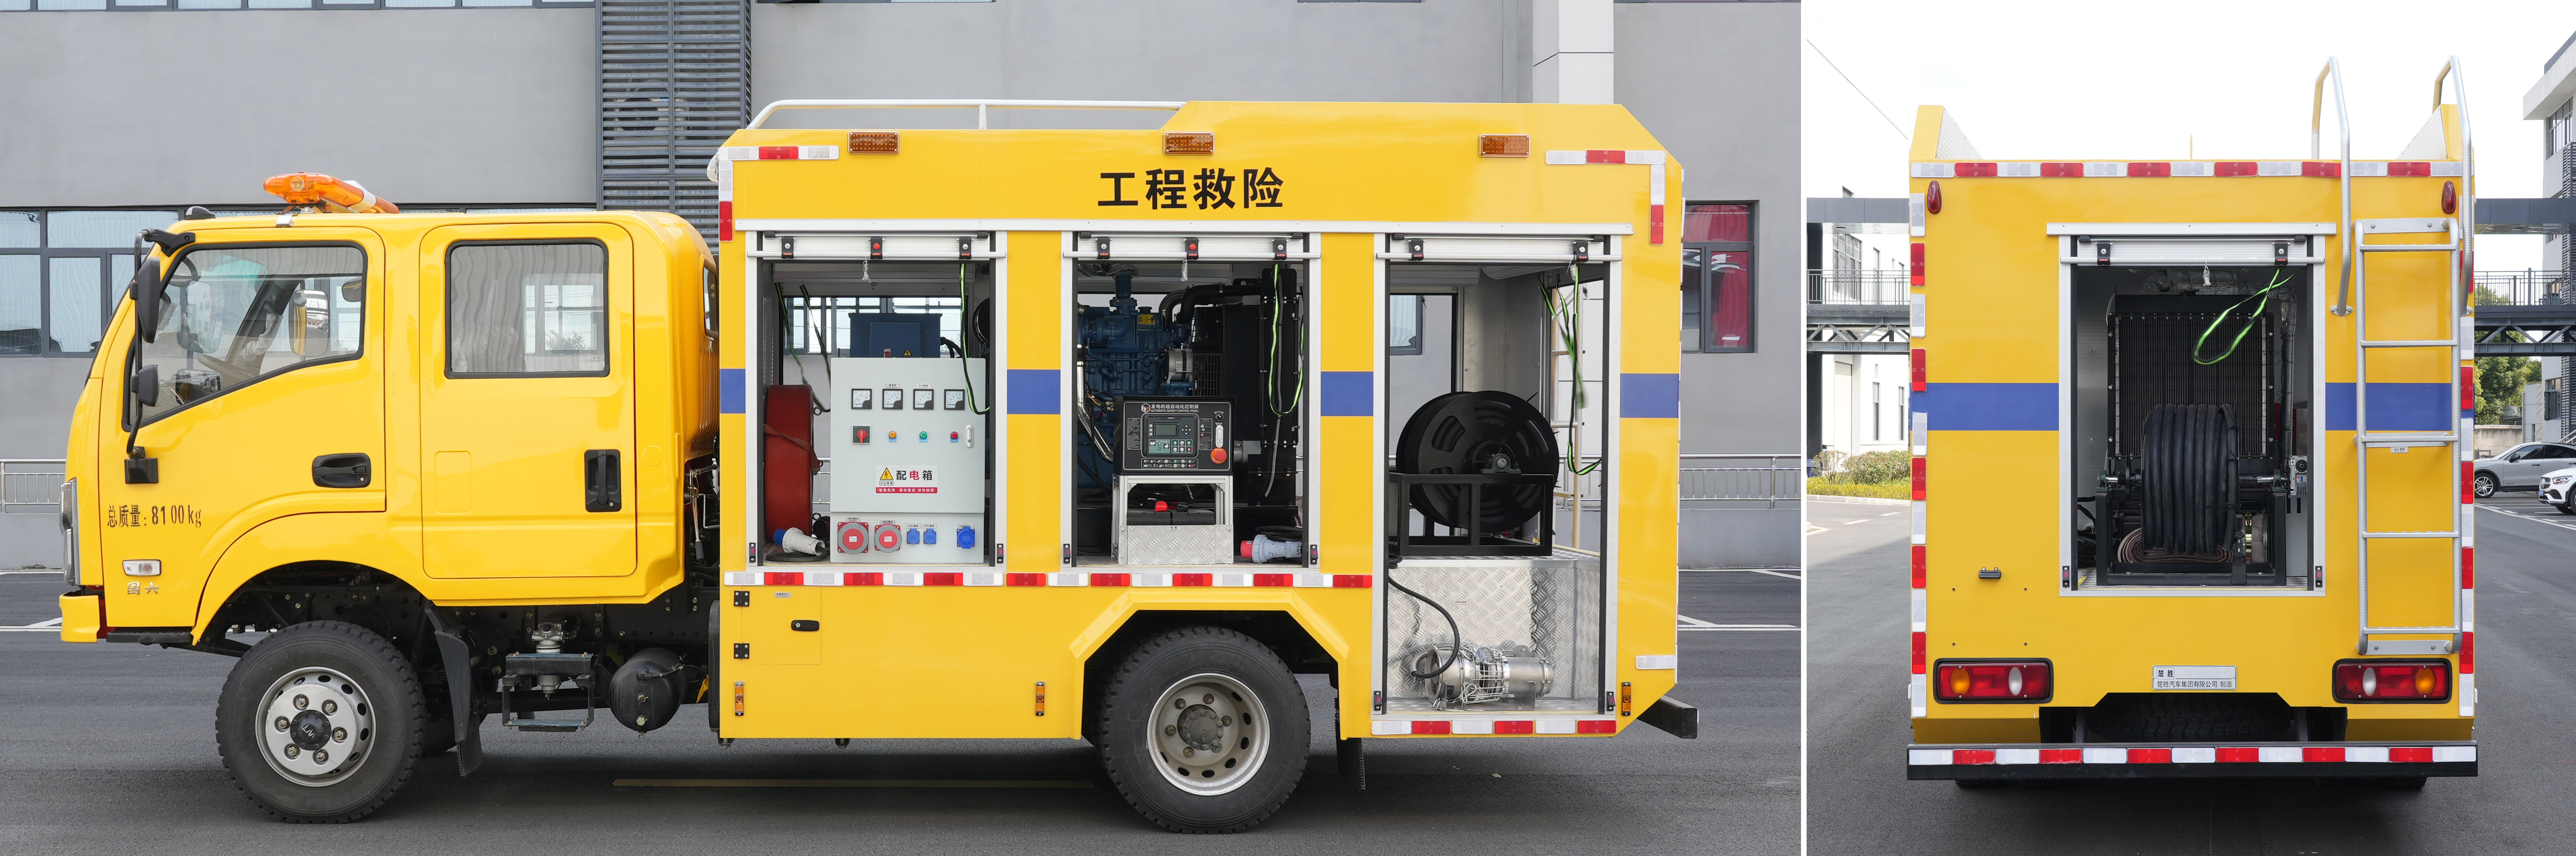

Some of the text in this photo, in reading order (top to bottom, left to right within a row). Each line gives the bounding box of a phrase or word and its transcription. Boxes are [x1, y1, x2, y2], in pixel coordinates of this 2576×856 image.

[1097, 167, 1284, 210] 工程救险
[896, 470, 933, 481] 配电箱
[127, 581, 159, 595] 国六
